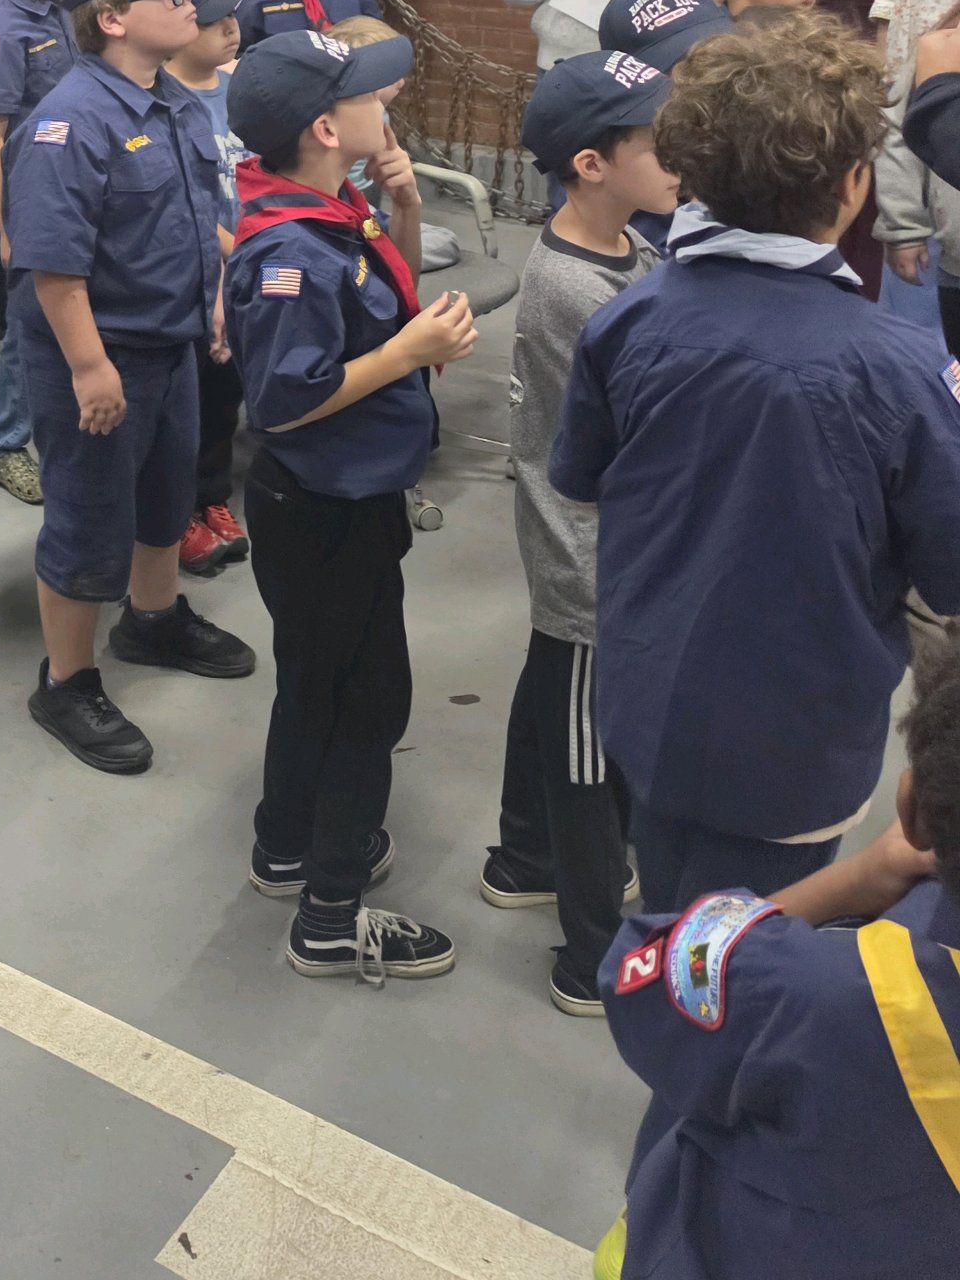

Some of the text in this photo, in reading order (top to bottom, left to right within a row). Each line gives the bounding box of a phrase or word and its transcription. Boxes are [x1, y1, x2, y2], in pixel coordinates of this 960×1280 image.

[615, 55, 648, 89] PACK
[622, 947, 657, 984] 2
[670, 952, 682, 1001] COUNCIL
[709, 967, 720, 1008] FUTURE
